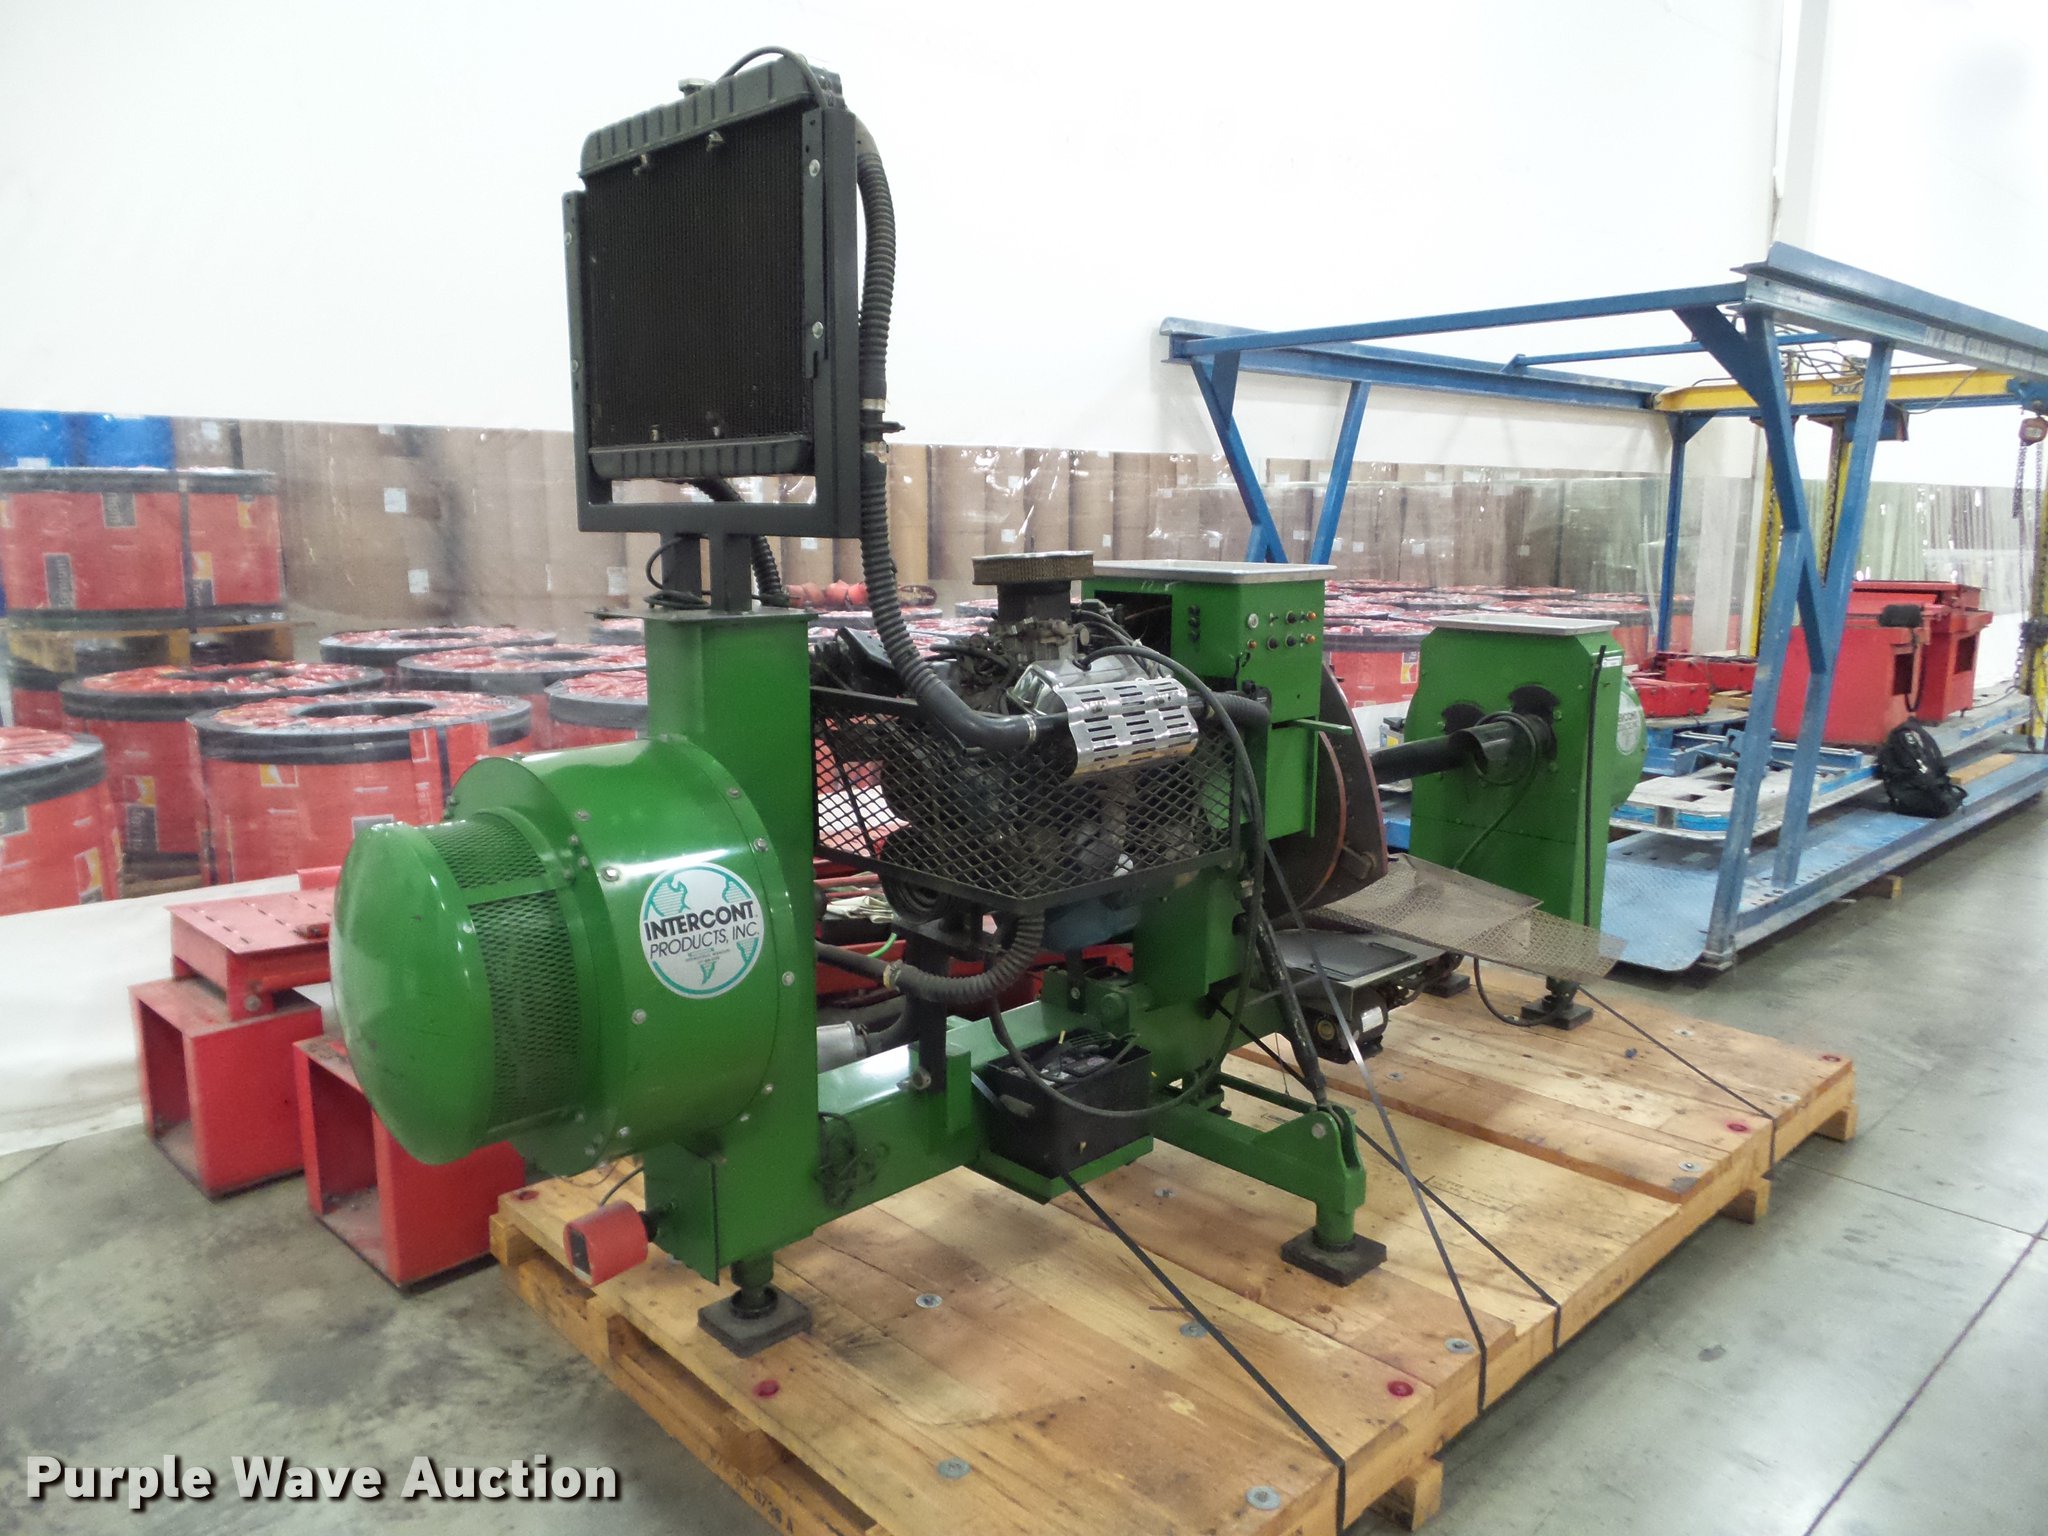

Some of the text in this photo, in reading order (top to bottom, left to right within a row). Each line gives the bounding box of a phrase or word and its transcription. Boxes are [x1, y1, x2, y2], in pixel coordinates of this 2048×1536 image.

[644, 900, 754, 941] INTERCONT
[650, 928, 729, 960] PRODUCTS,
[732, 921, 760, 940] INC.
